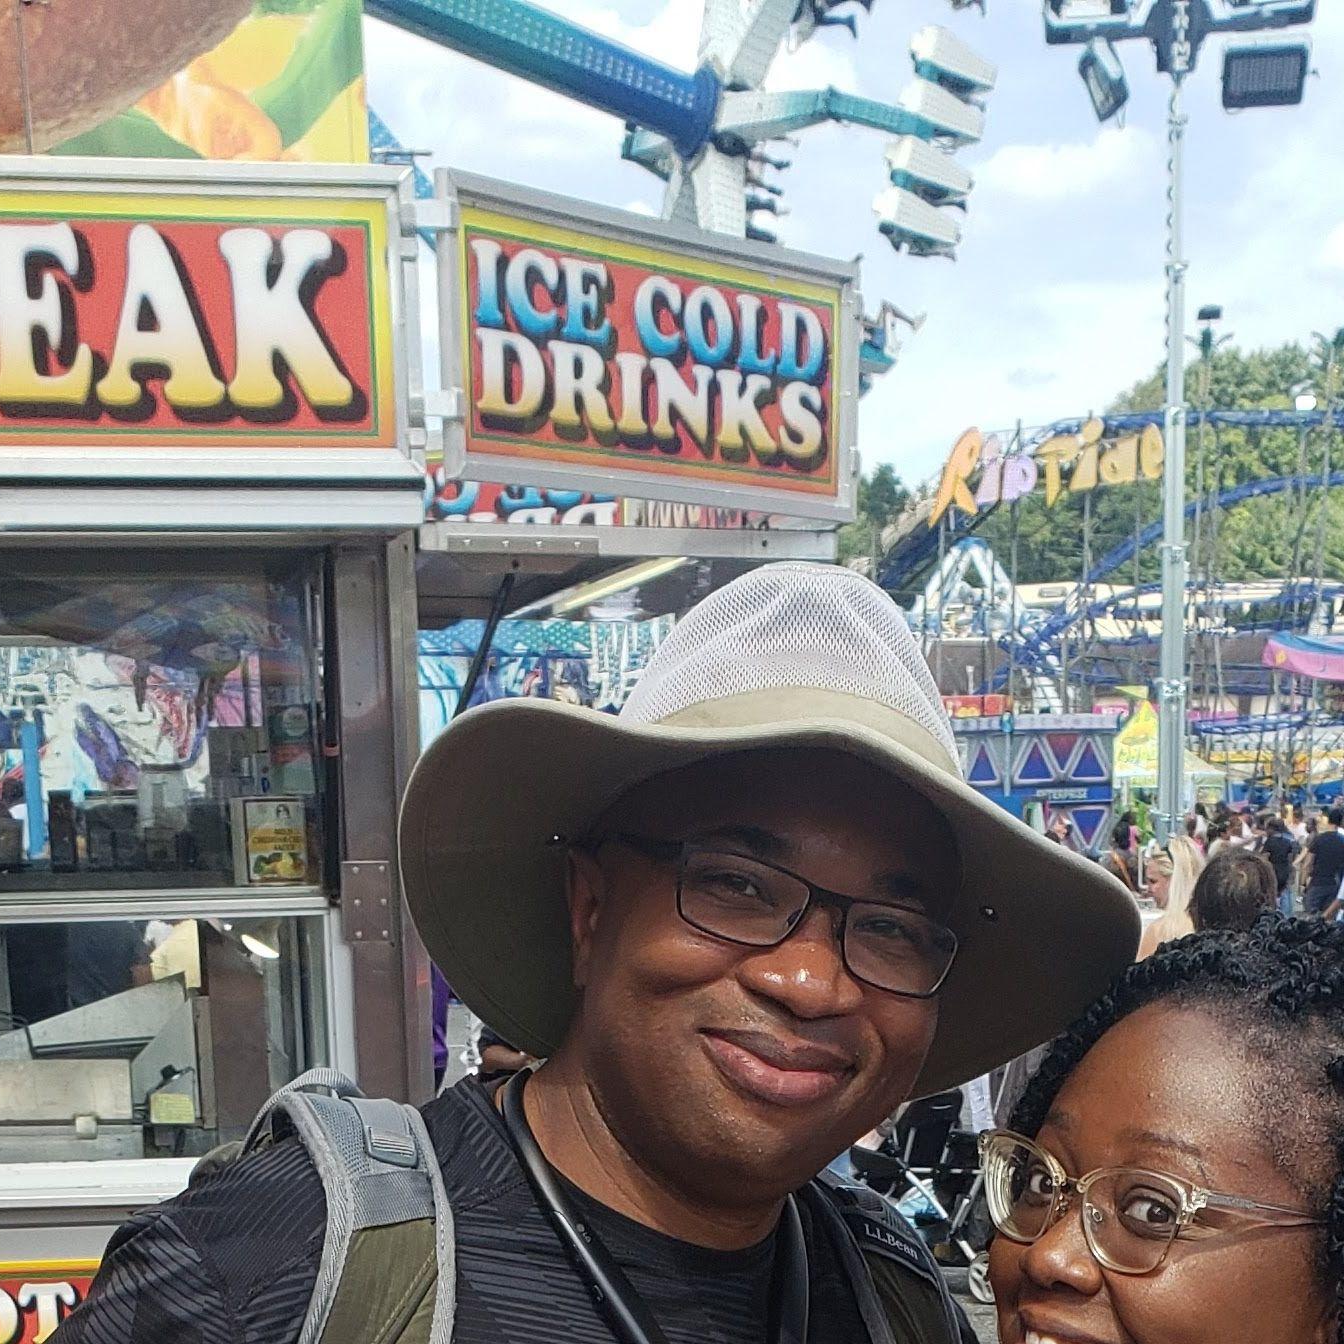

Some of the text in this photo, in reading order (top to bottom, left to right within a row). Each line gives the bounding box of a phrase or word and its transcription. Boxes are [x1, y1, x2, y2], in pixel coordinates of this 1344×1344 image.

[470, 238, 826, 382] ICE COLD
[475, 326, 824, 460] DRINKS
